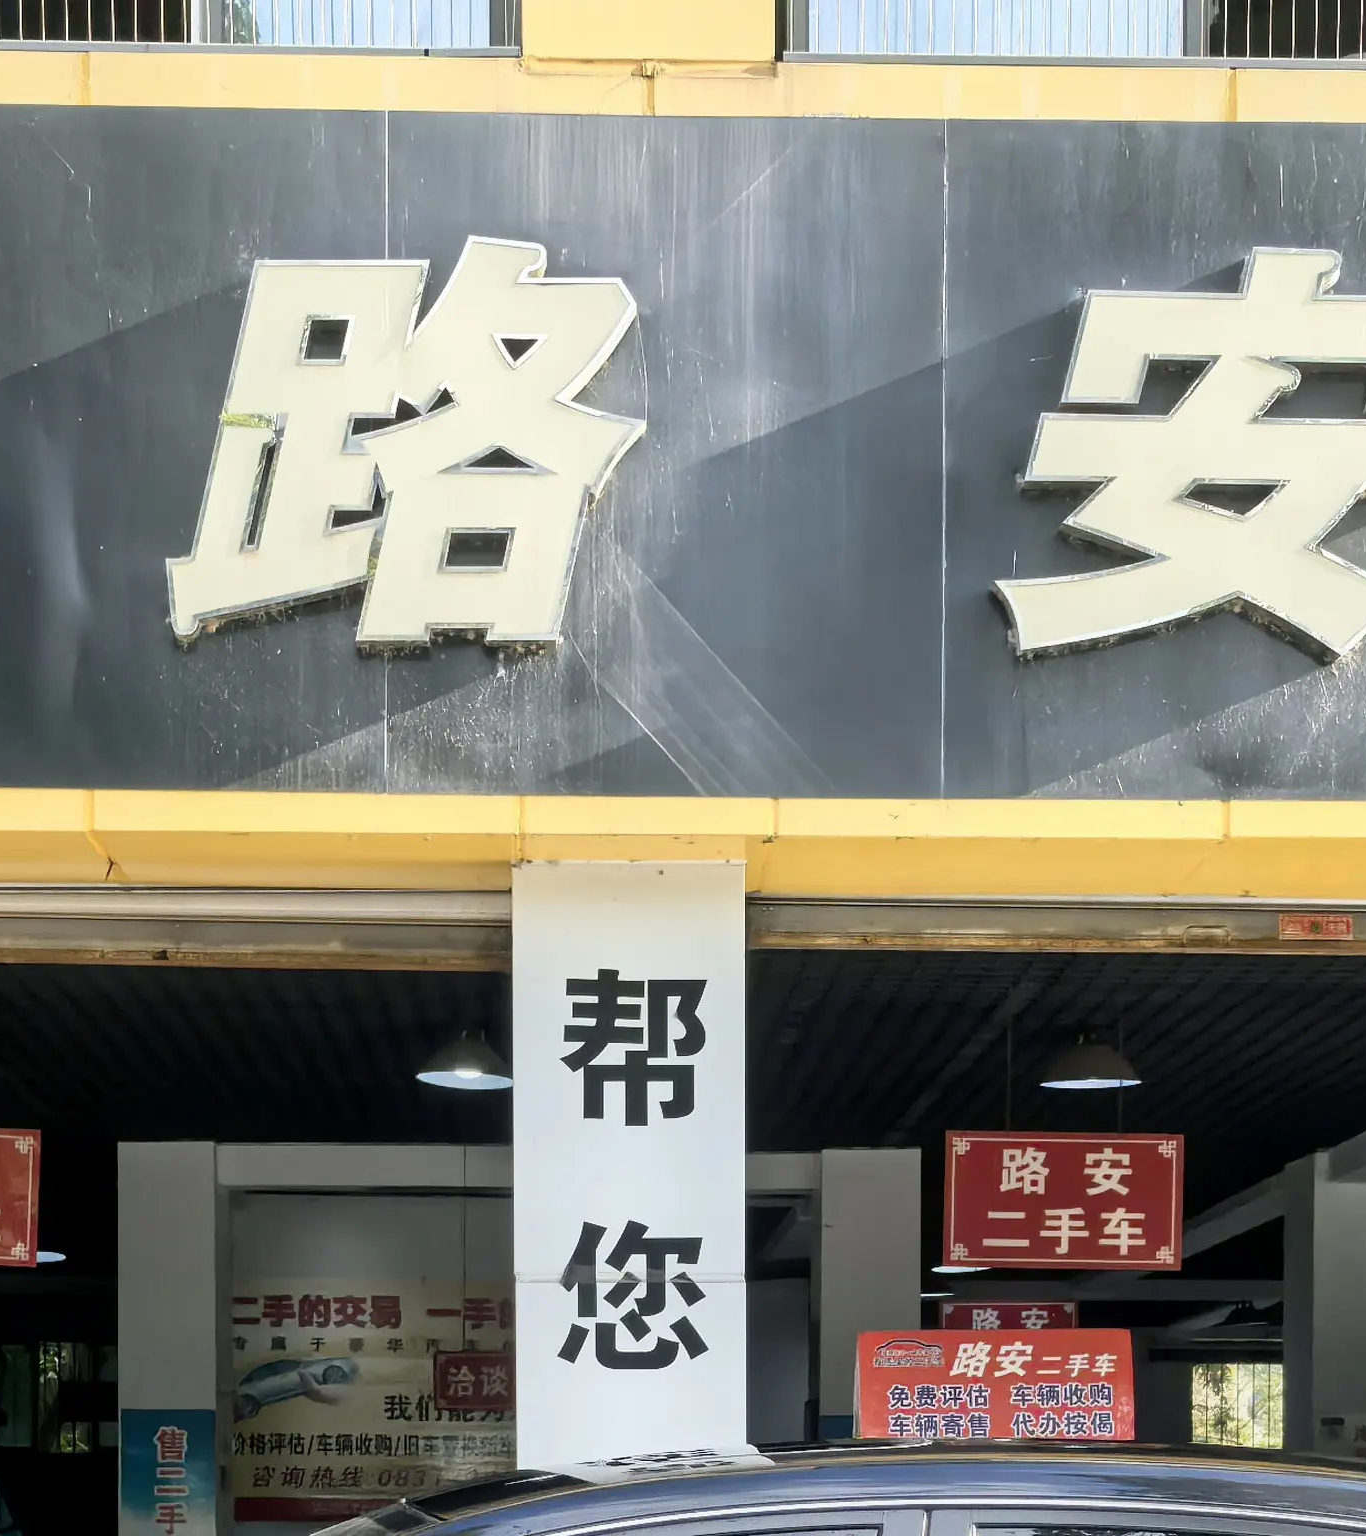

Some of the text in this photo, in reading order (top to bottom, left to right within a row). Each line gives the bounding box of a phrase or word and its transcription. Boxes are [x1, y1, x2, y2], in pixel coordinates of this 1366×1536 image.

[999, 1147, 1133, 1196] 路安
[982, 1207, 1147, 1255] 二手车
[232, 1294, 402, 1330] 二手的交易
[949, 1341, 1117, 1378] 路安二手车
[447, 1366, 509, 1397] 洽谈
[888, 1383, 1114, 1410] 免费评估 车辆收购
[889, 1411, 990, 1438] 车辆寄售
[252, 1466, 365, 1489] 咨询热线
